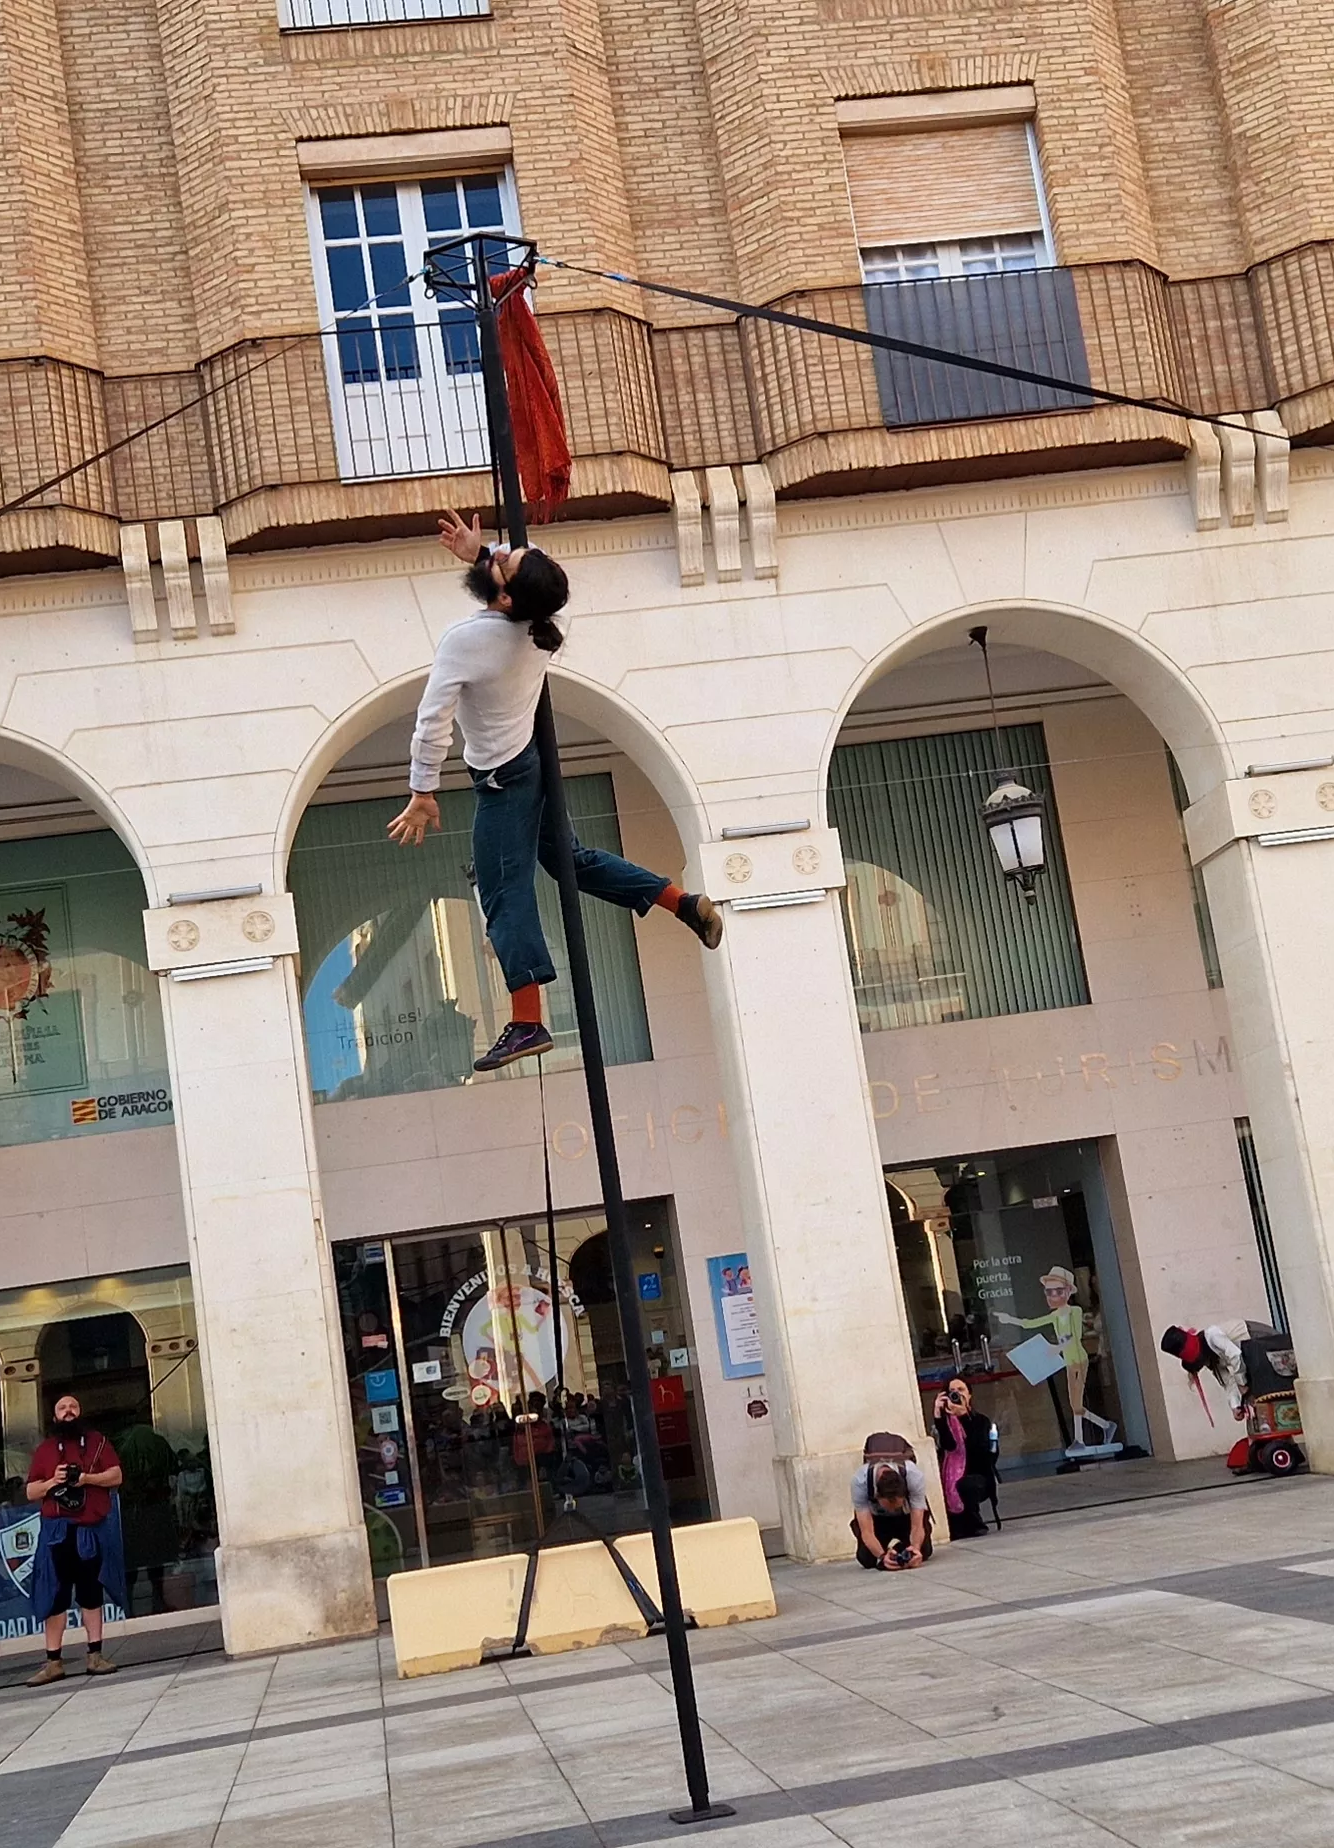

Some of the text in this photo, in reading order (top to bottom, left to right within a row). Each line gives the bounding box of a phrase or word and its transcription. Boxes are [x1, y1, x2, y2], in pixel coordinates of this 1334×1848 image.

[336, 1028, 414, 1051] Tradición
[867, 1073, 950, 1119] DE
[991, 1035, 1234, 1101] TURISM
[97, 1089, 167, 1108] GOBIERNO
[98, 1107, 117, 1121] DE
[973, 1255, 1022, 1270] Por la otra
[439, 1264, 517, 1338] BIENVENIOS
[978, 1287, 1014, 1300] Gracias
